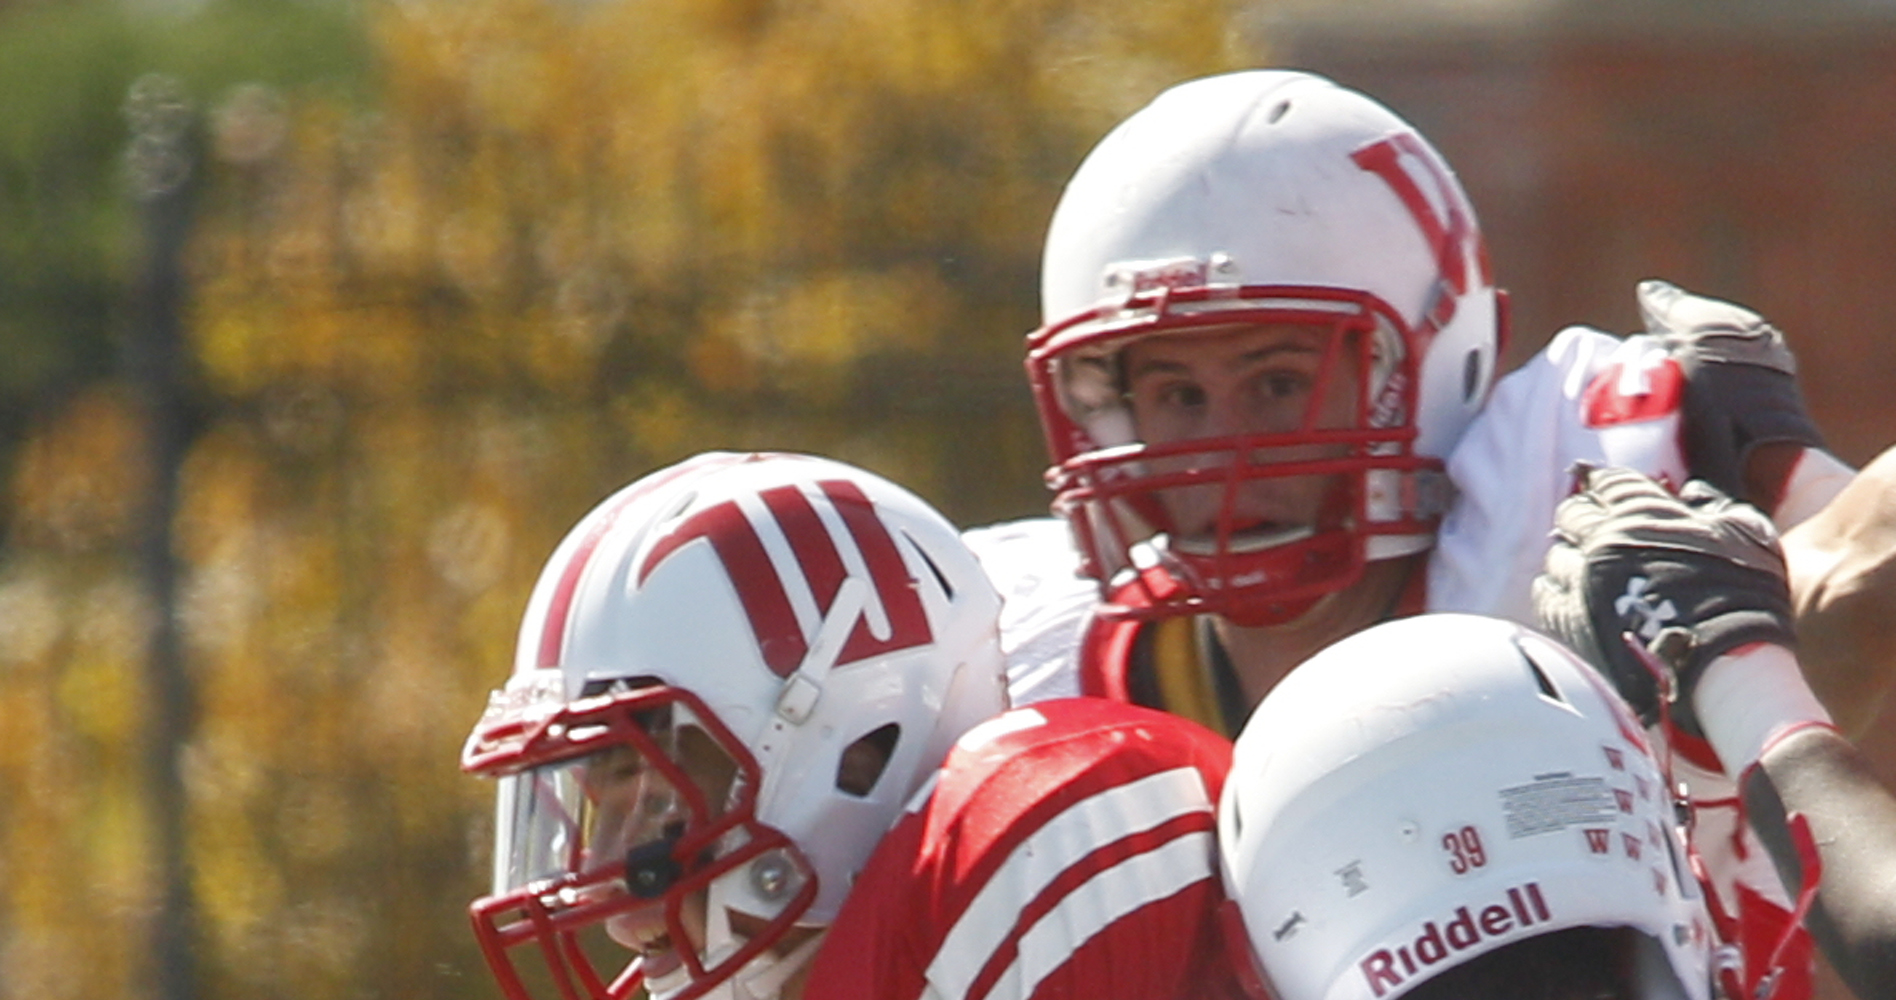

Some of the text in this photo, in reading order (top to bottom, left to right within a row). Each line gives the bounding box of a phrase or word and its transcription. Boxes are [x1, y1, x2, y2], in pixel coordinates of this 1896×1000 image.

[1441, 825, 1488, 875] 39
[1583, 828, 1610, 854] W
[1360, 882, 1552, 998] Riddell
